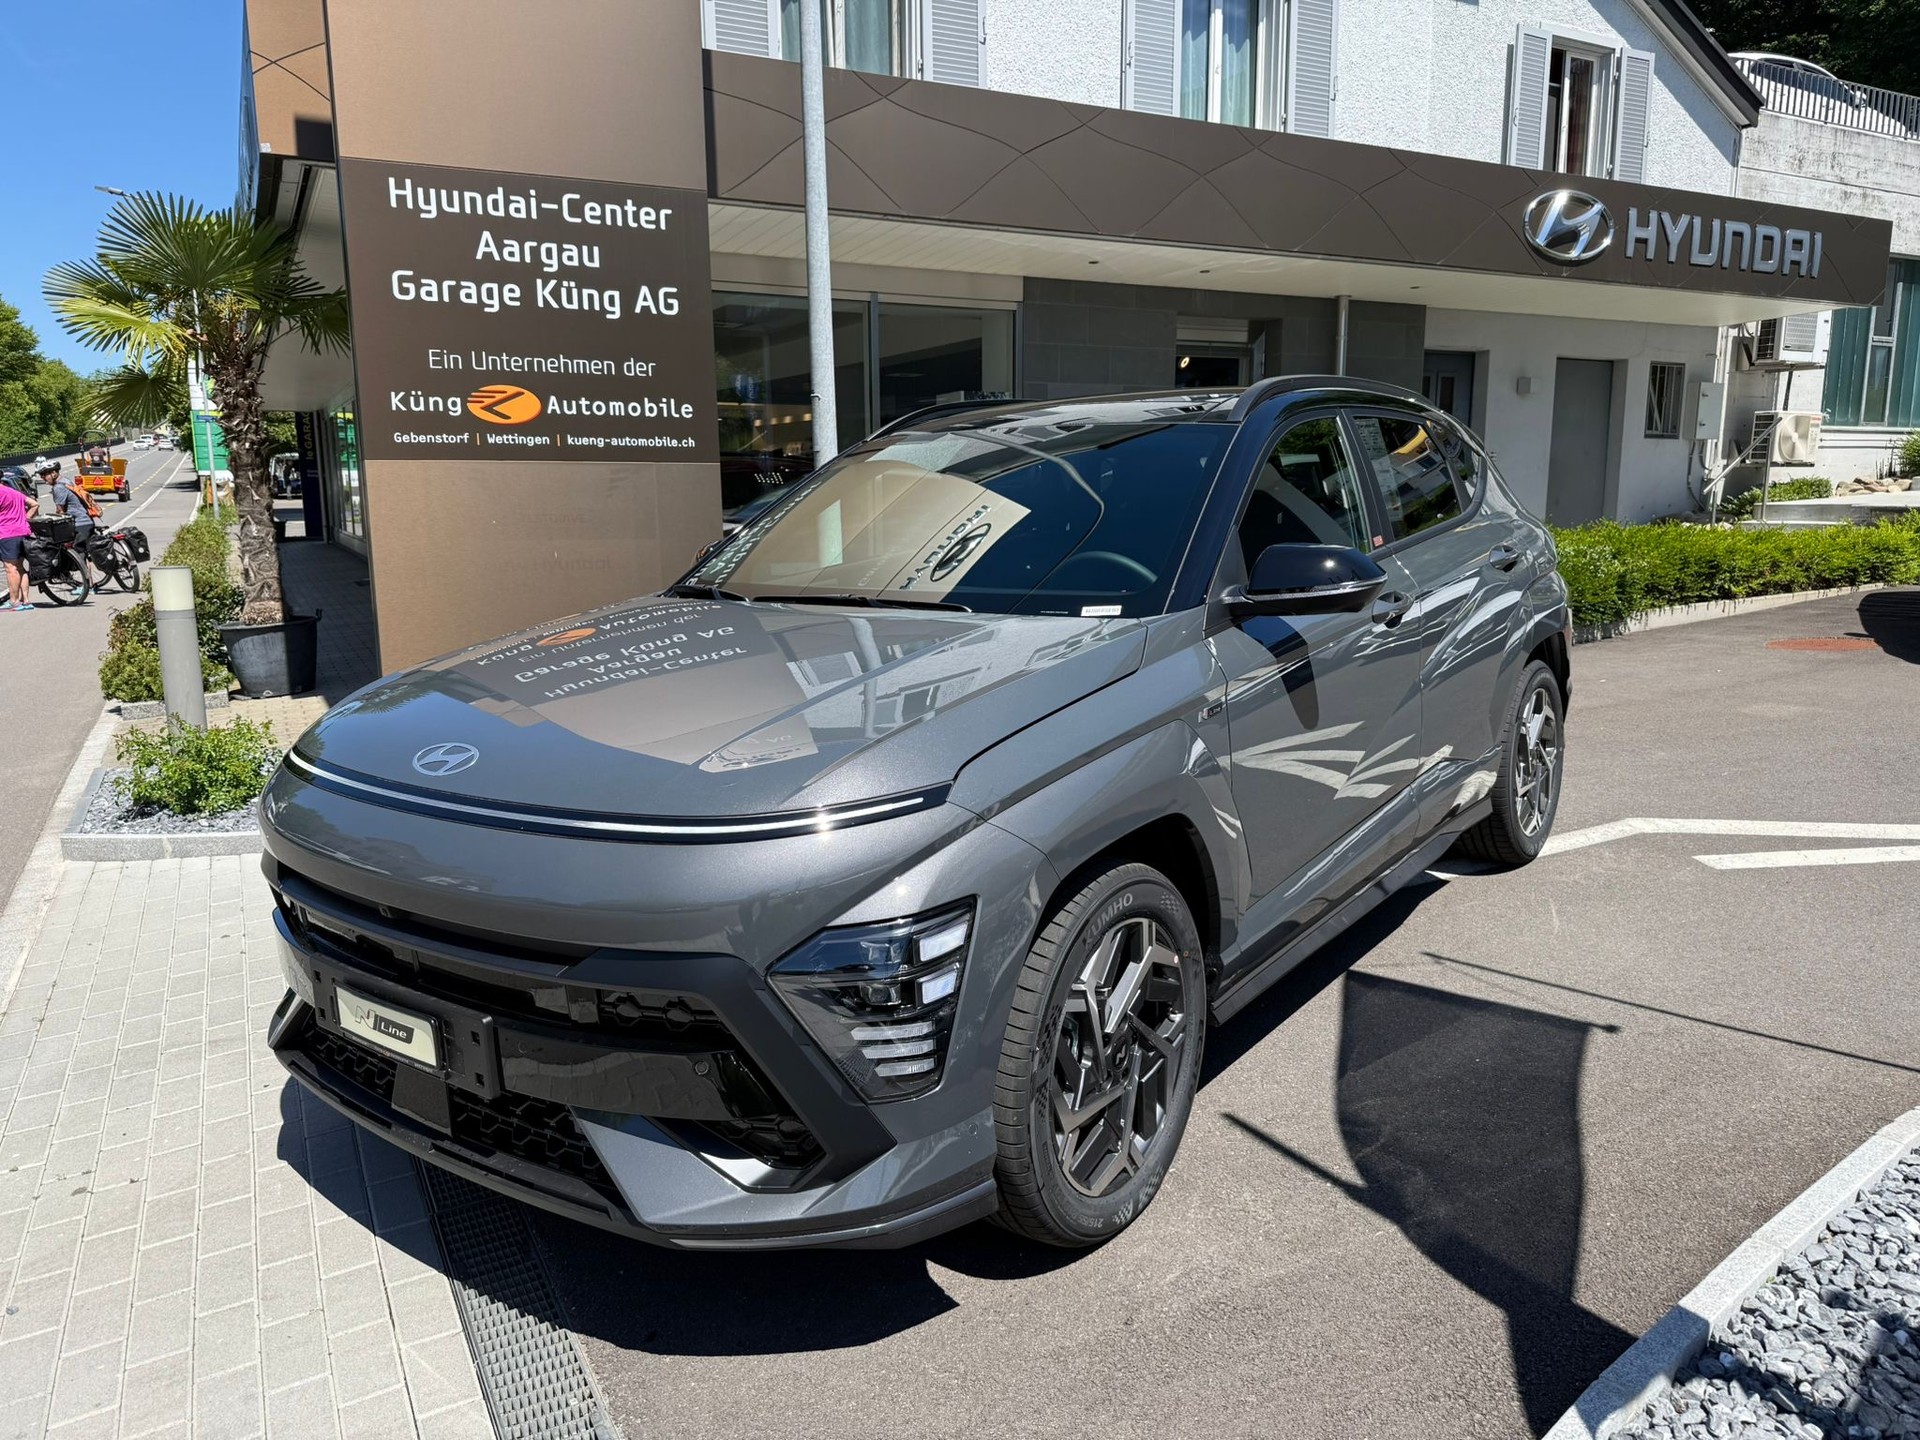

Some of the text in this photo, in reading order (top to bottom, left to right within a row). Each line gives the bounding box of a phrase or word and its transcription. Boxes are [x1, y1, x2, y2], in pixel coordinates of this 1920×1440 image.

[388, 176, 672, 230] Hyundai-Center
[475, 230, 601, 272] Aargau
[1625, 206, 1823, 279] HYUNDAI
[391, 270, 680, 319] Garage Küng AG
[428, 349, 656, 377] Ein Unternehmen der
[390, 391, 694, 419] Küng Automobile
[393, 431, 696, 448] Gebenstorf Wettingen kueng-automobile.ch
[1084, 892, 1133, 950] KUMHO
[380, 1021, 407, 1039] Line
